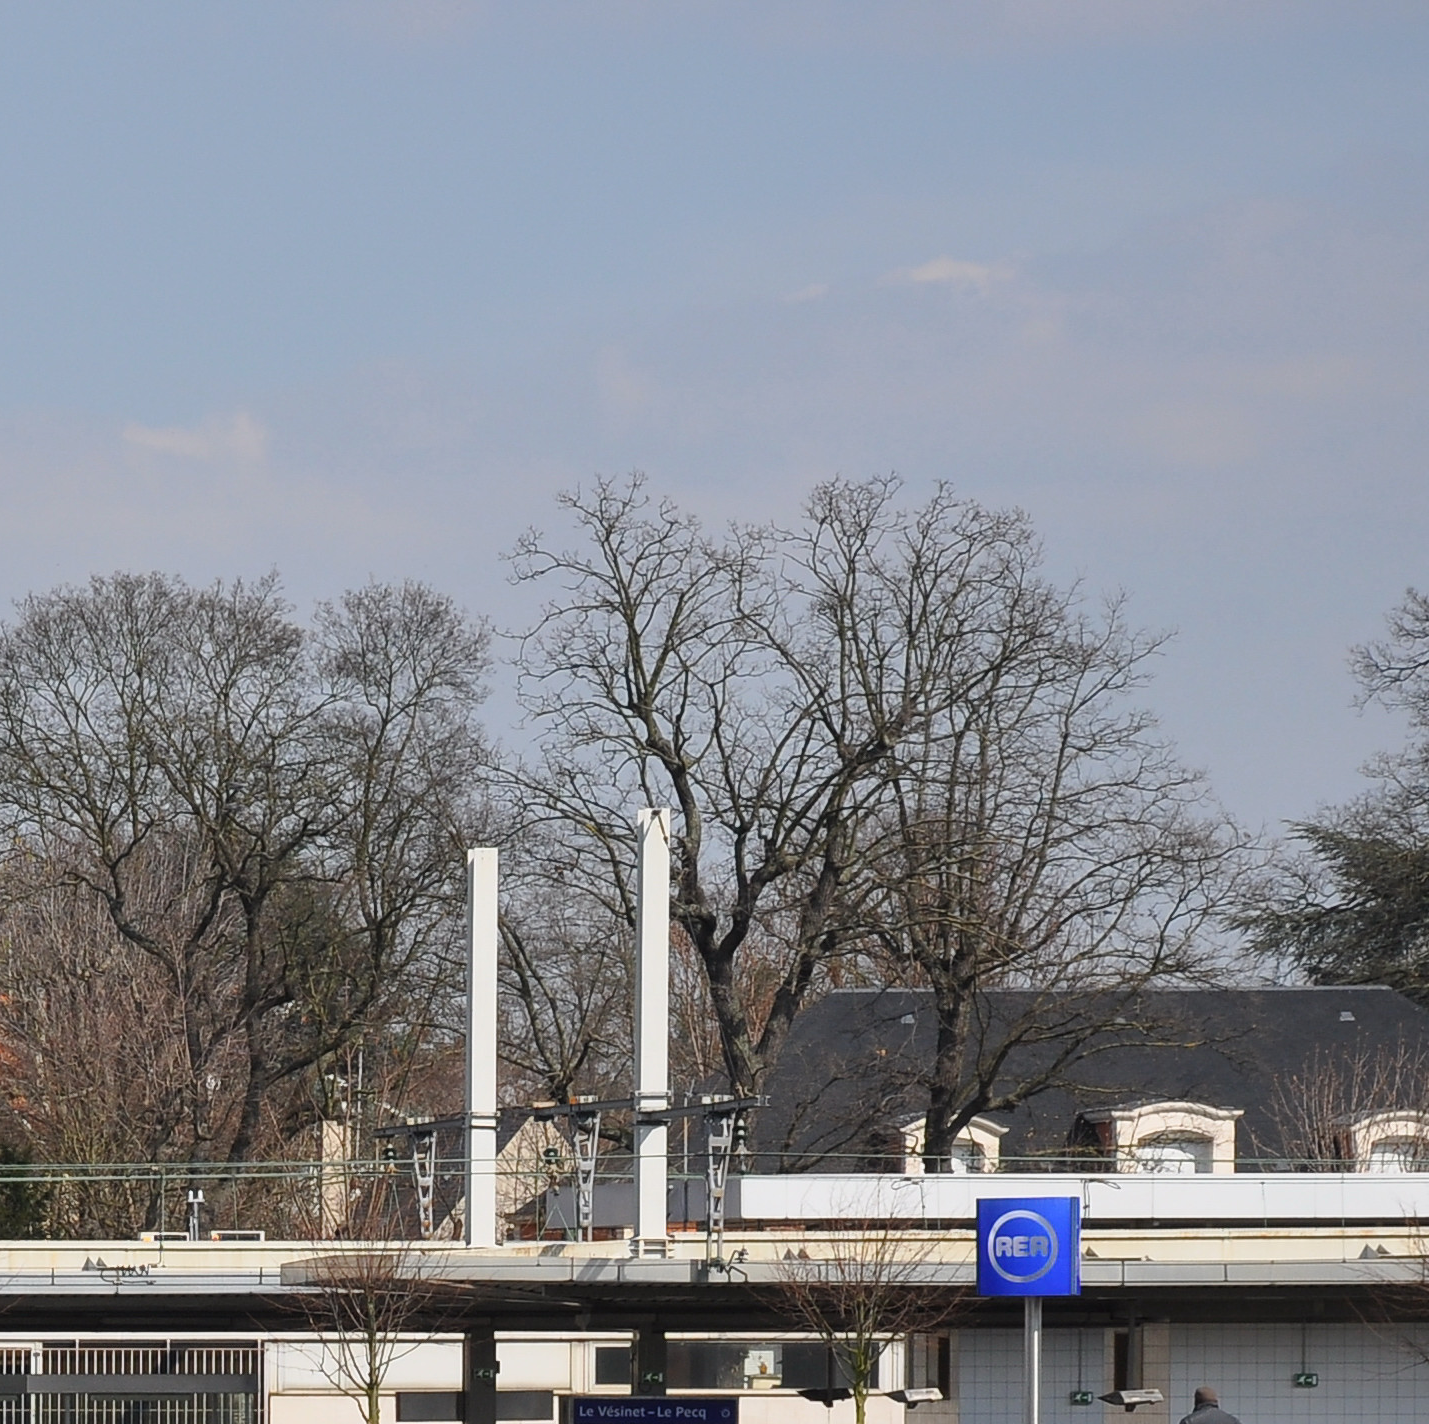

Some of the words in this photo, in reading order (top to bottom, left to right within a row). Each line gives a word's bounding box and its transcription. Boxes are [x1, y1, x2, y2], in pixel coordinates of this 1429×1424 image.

[996, 1236, 1048, 1257] RER
[579, 1405, 595, 1417] Le
[598, 1405, 646, 1418] Vésinet
[657, 1405, 672, 1418] Le
[675, 1406, 707, 1420] Pecq
